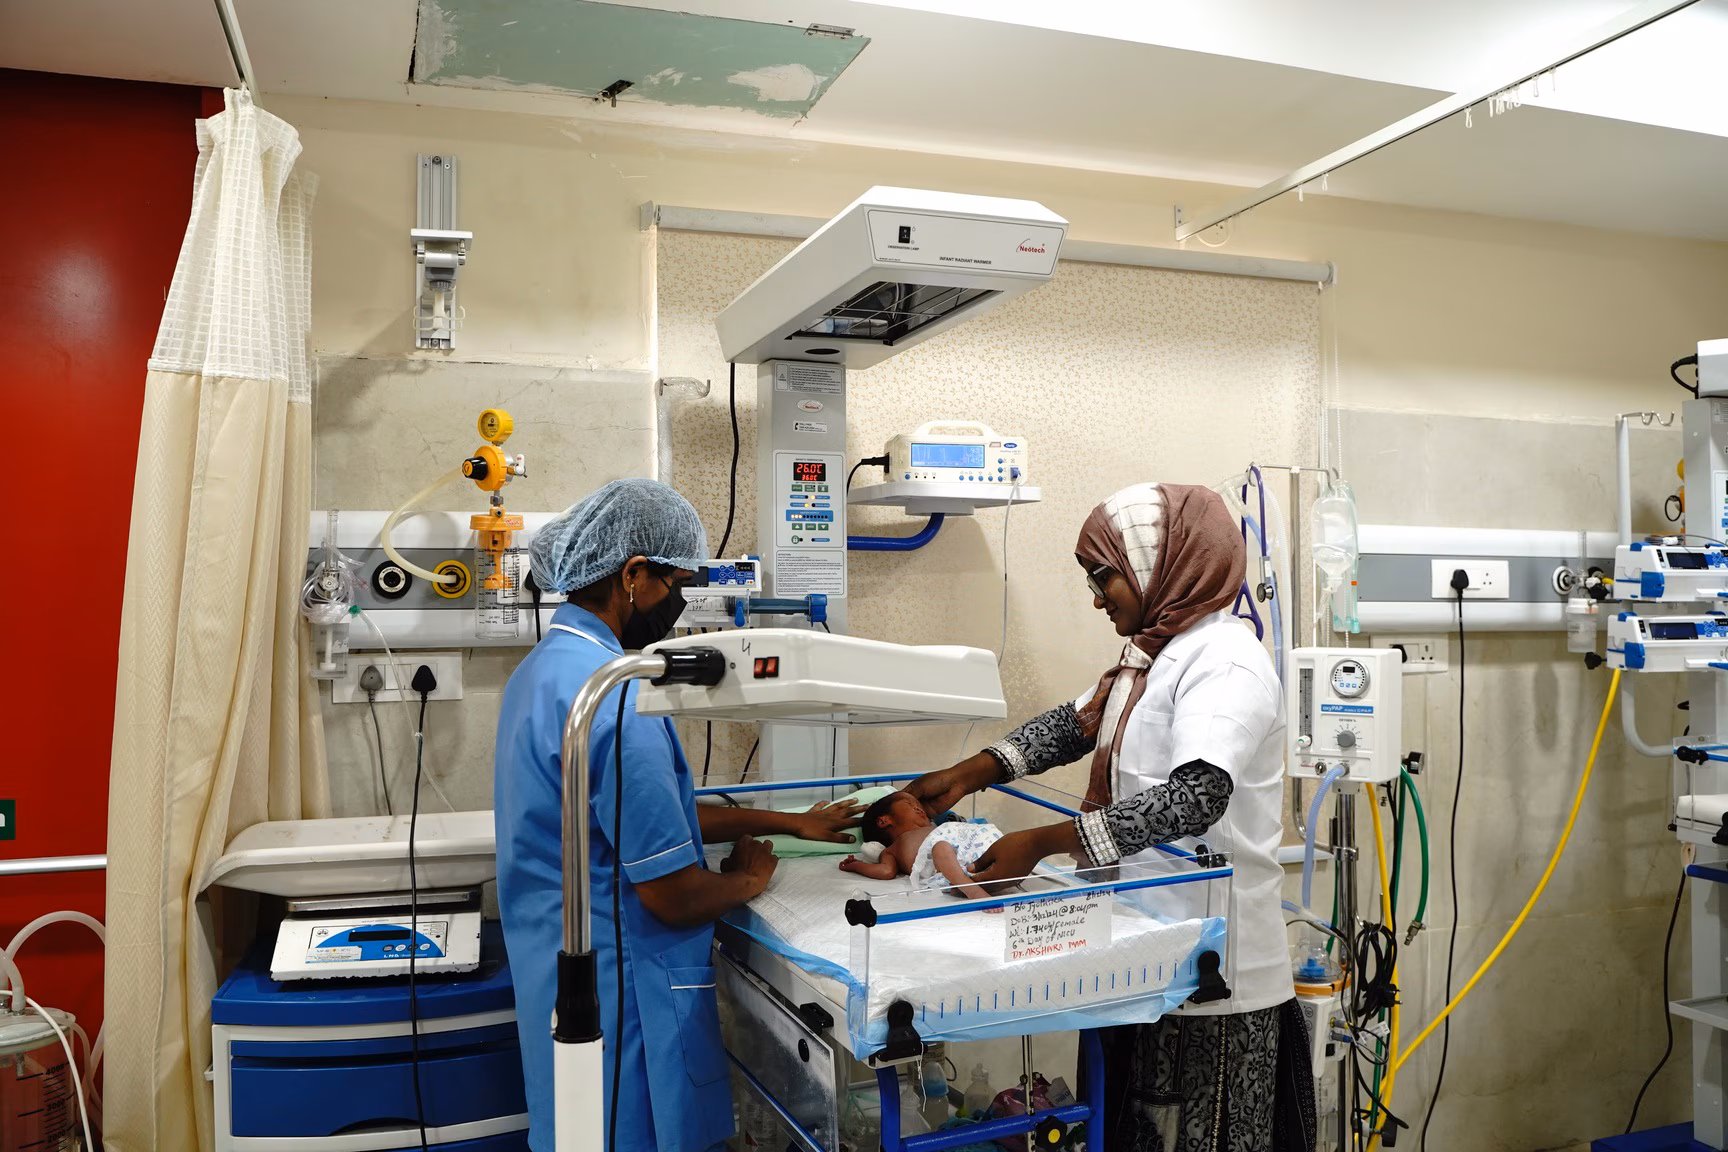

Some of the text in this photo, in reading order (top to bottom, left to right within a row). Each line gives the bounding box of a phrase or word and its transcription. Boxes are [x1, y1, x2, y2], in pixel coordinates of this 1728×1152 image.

[46, 1063, 66, 1075] 4000
[47, 1098, 66, 1111] 3000
[47, 1129, 66, 1143] 2000
